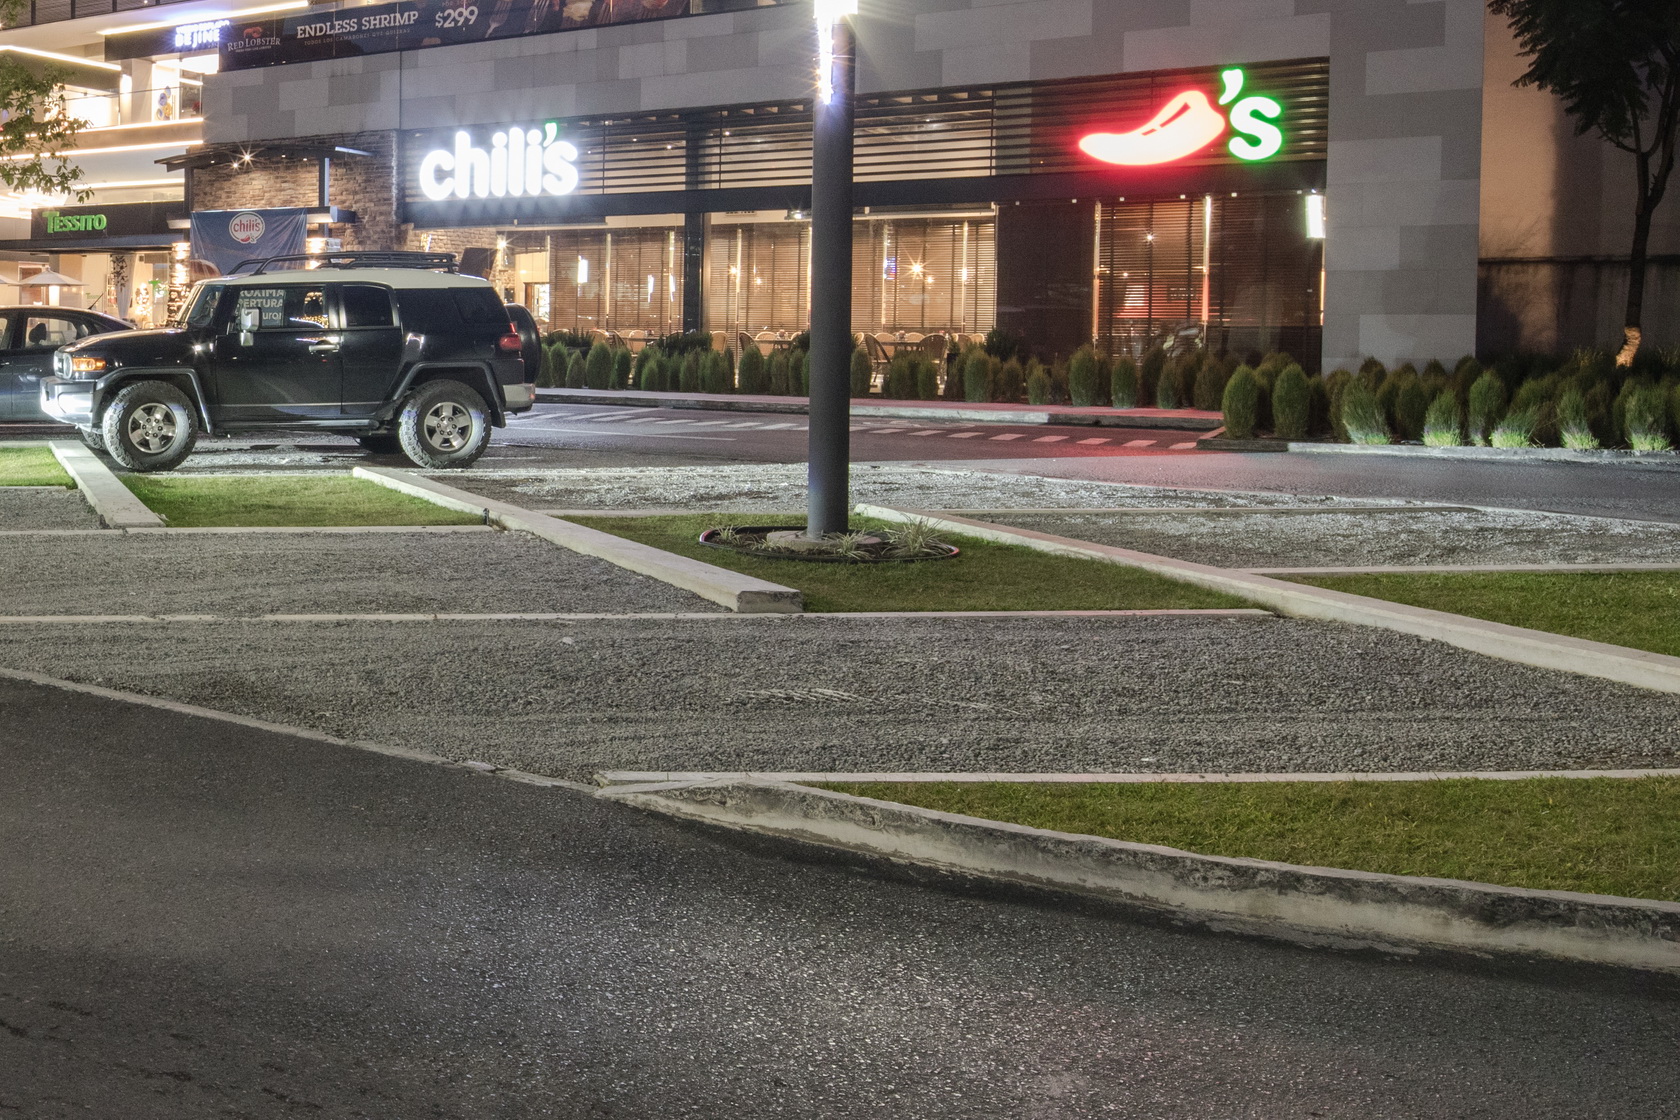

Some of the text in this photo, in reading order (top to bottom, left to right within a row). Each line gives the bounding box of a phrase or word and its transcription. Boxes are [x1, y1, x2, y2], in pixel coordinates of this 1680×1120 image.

[297, 11, 419, 39] ENDLESS SHRIMP
[435, 6, 479, 28] $299
[227, 40, 244, 51] RED
[246, 37, 281, 48] LOBSTER
